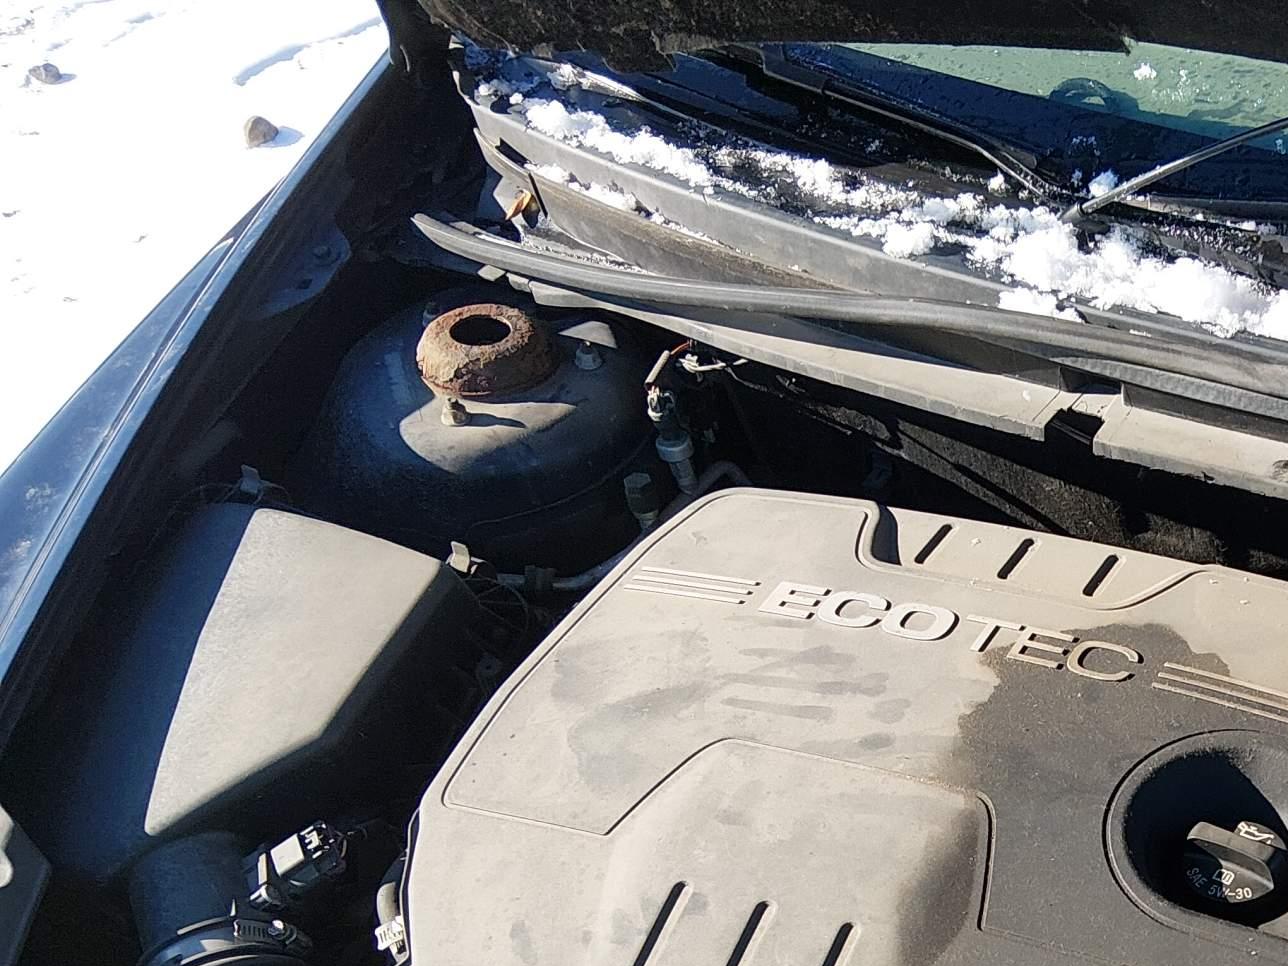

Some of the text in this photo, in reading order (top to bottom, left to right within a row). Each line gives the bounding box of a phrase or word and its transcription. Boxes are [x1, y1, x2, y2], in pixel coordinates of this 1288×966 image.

[758, 582, 1144, 682] ECOTEC
[1186, 867, 1252, 899] SAE 5W-30
